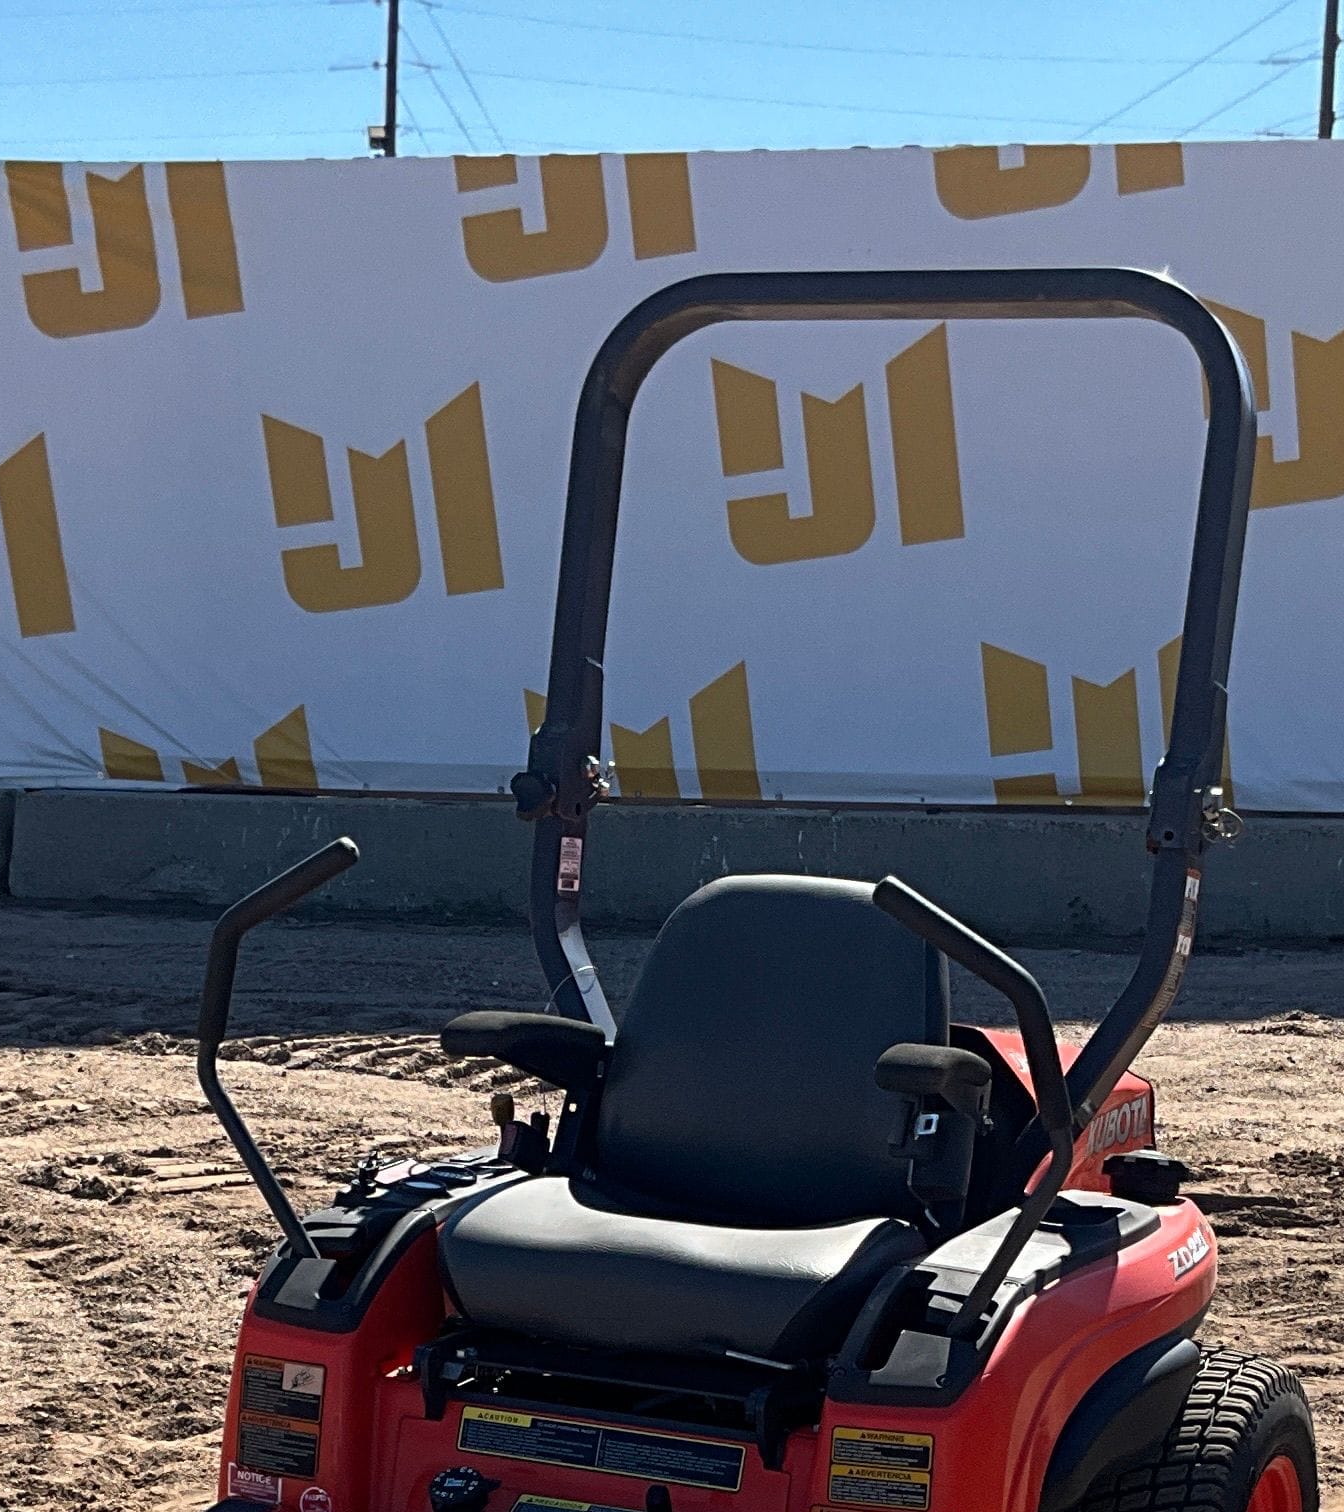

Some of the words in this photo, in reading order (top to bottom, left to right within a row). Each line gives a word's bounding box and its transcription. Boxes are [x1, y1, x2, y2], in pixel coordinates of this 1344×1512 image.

[1088, 1097, 1149, 1154] KUBOTA
[484, 1413, 520, 1424] CAUTION
[867, 1432, 905, 1443] WARNING
[237, 1470, 272, 1485] NOTICE
[855, 1469, 912, 1481] ADVERTENCIA
